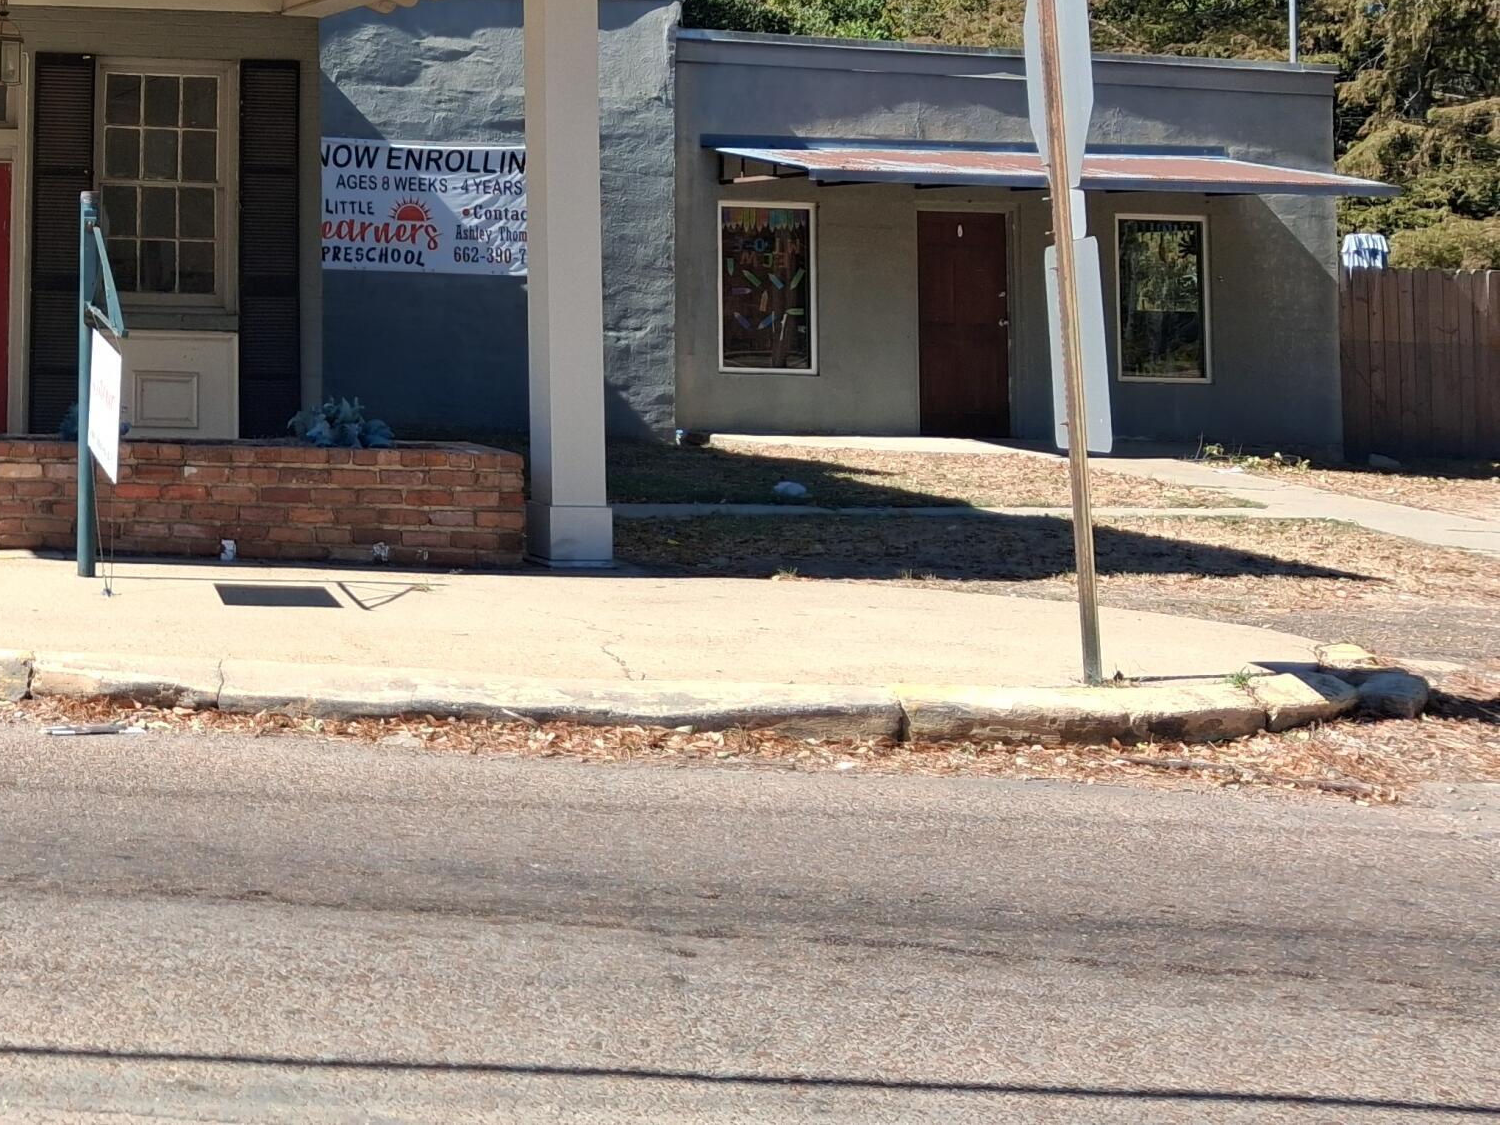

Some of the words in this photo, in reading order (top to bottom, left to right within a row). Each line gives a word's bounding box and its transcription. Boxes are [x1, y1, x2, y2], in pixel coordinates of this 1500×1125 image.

[386, 146, 526, 174] ENROLLIN
[336, 174, 377, 190] AGES
[381, 176, 390, 190] 8
[394, 176, 448, 193] WEEKS
[473, 179, 523, 195] YEARS
[325, 199, 375, 215] LITTLE
[455, 225, 492, 243] Ashley
[321, 246, 425, 267] PRESCHOOL
